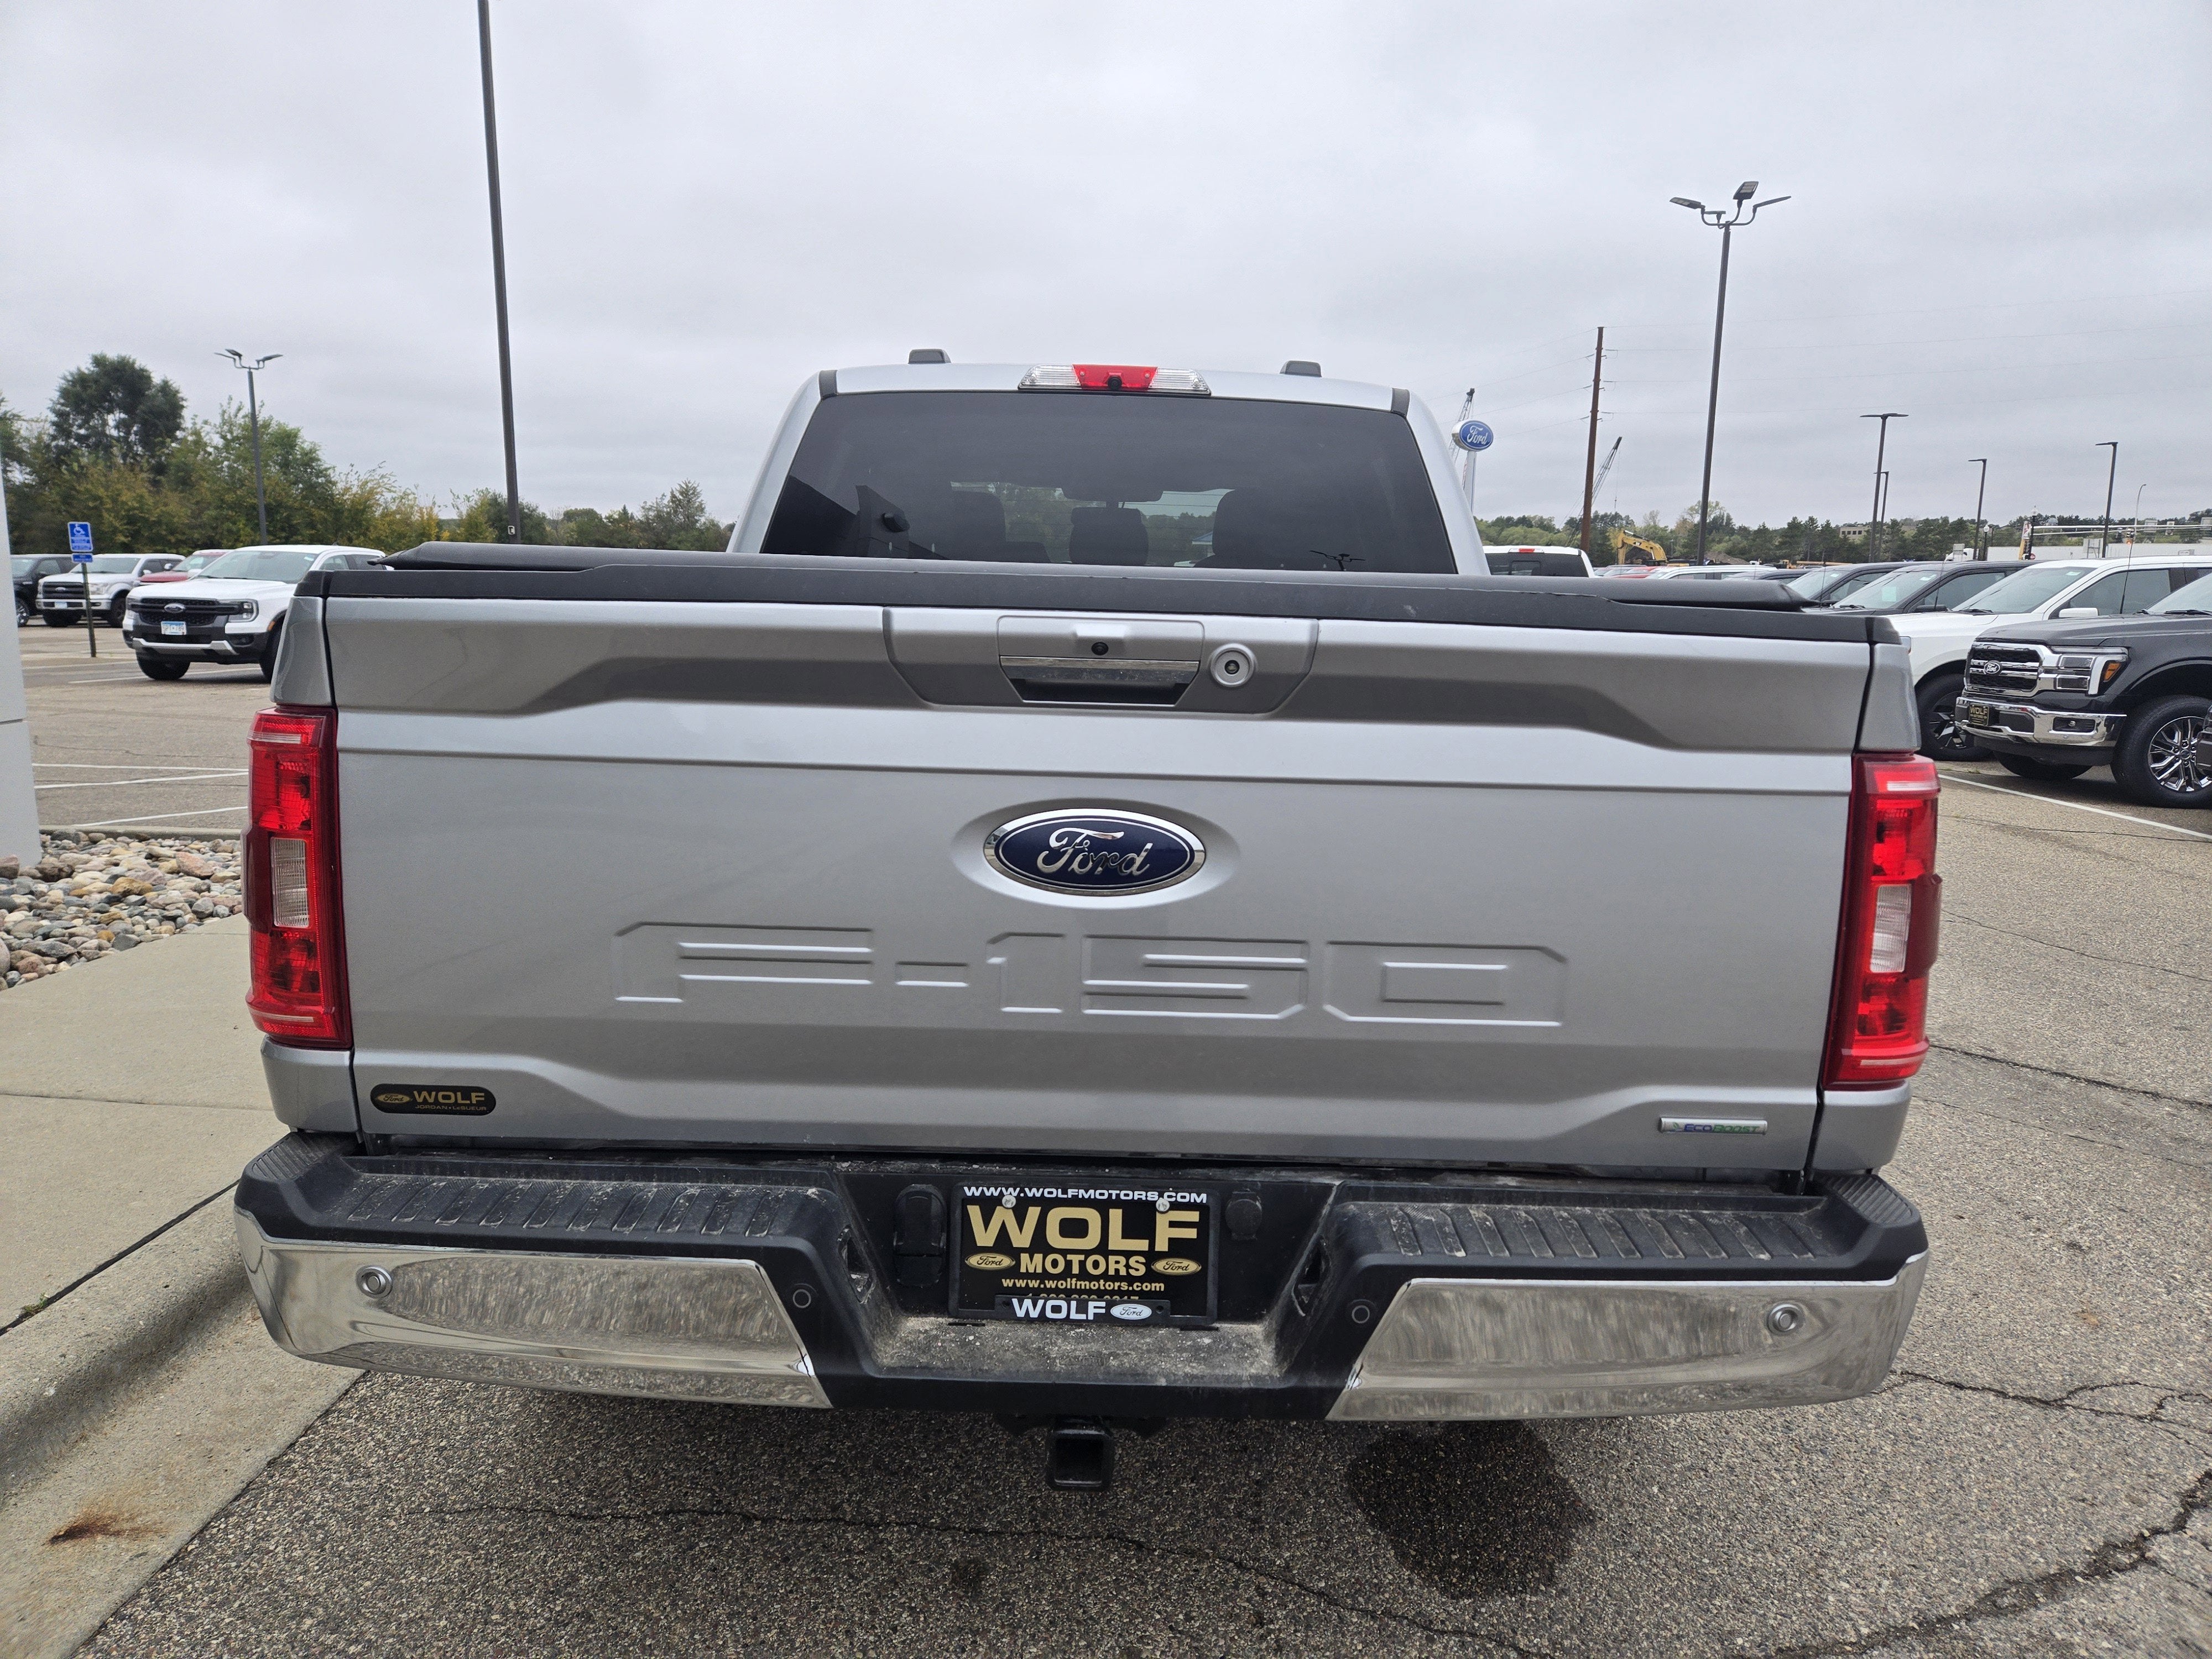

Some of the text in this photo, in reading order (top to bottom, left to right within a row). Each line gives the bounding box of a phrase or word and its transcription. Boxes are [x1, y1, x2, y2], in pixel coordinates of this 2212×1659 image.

[1467, 425, 1488, 445] Ford
[1970, 707, 1988, 715] WOLF
[1036, 827, 1154, 876] Ford
[613, 920, 1568, 1027] F-150
[413, 1091, 485, 1104] WOLF
[963, 1186, 1207, 1203] WWW.WOLFMOTORS.COM
[966, 1204, 1200, 1252] WOLF
[977, 1253, 1190, 1276] Ford MOTORS Ford
[1001, 1278, 1165, 1292] www.wolfmotors.com
[1011, 1298, 1144, 1320] WOLF Ford
